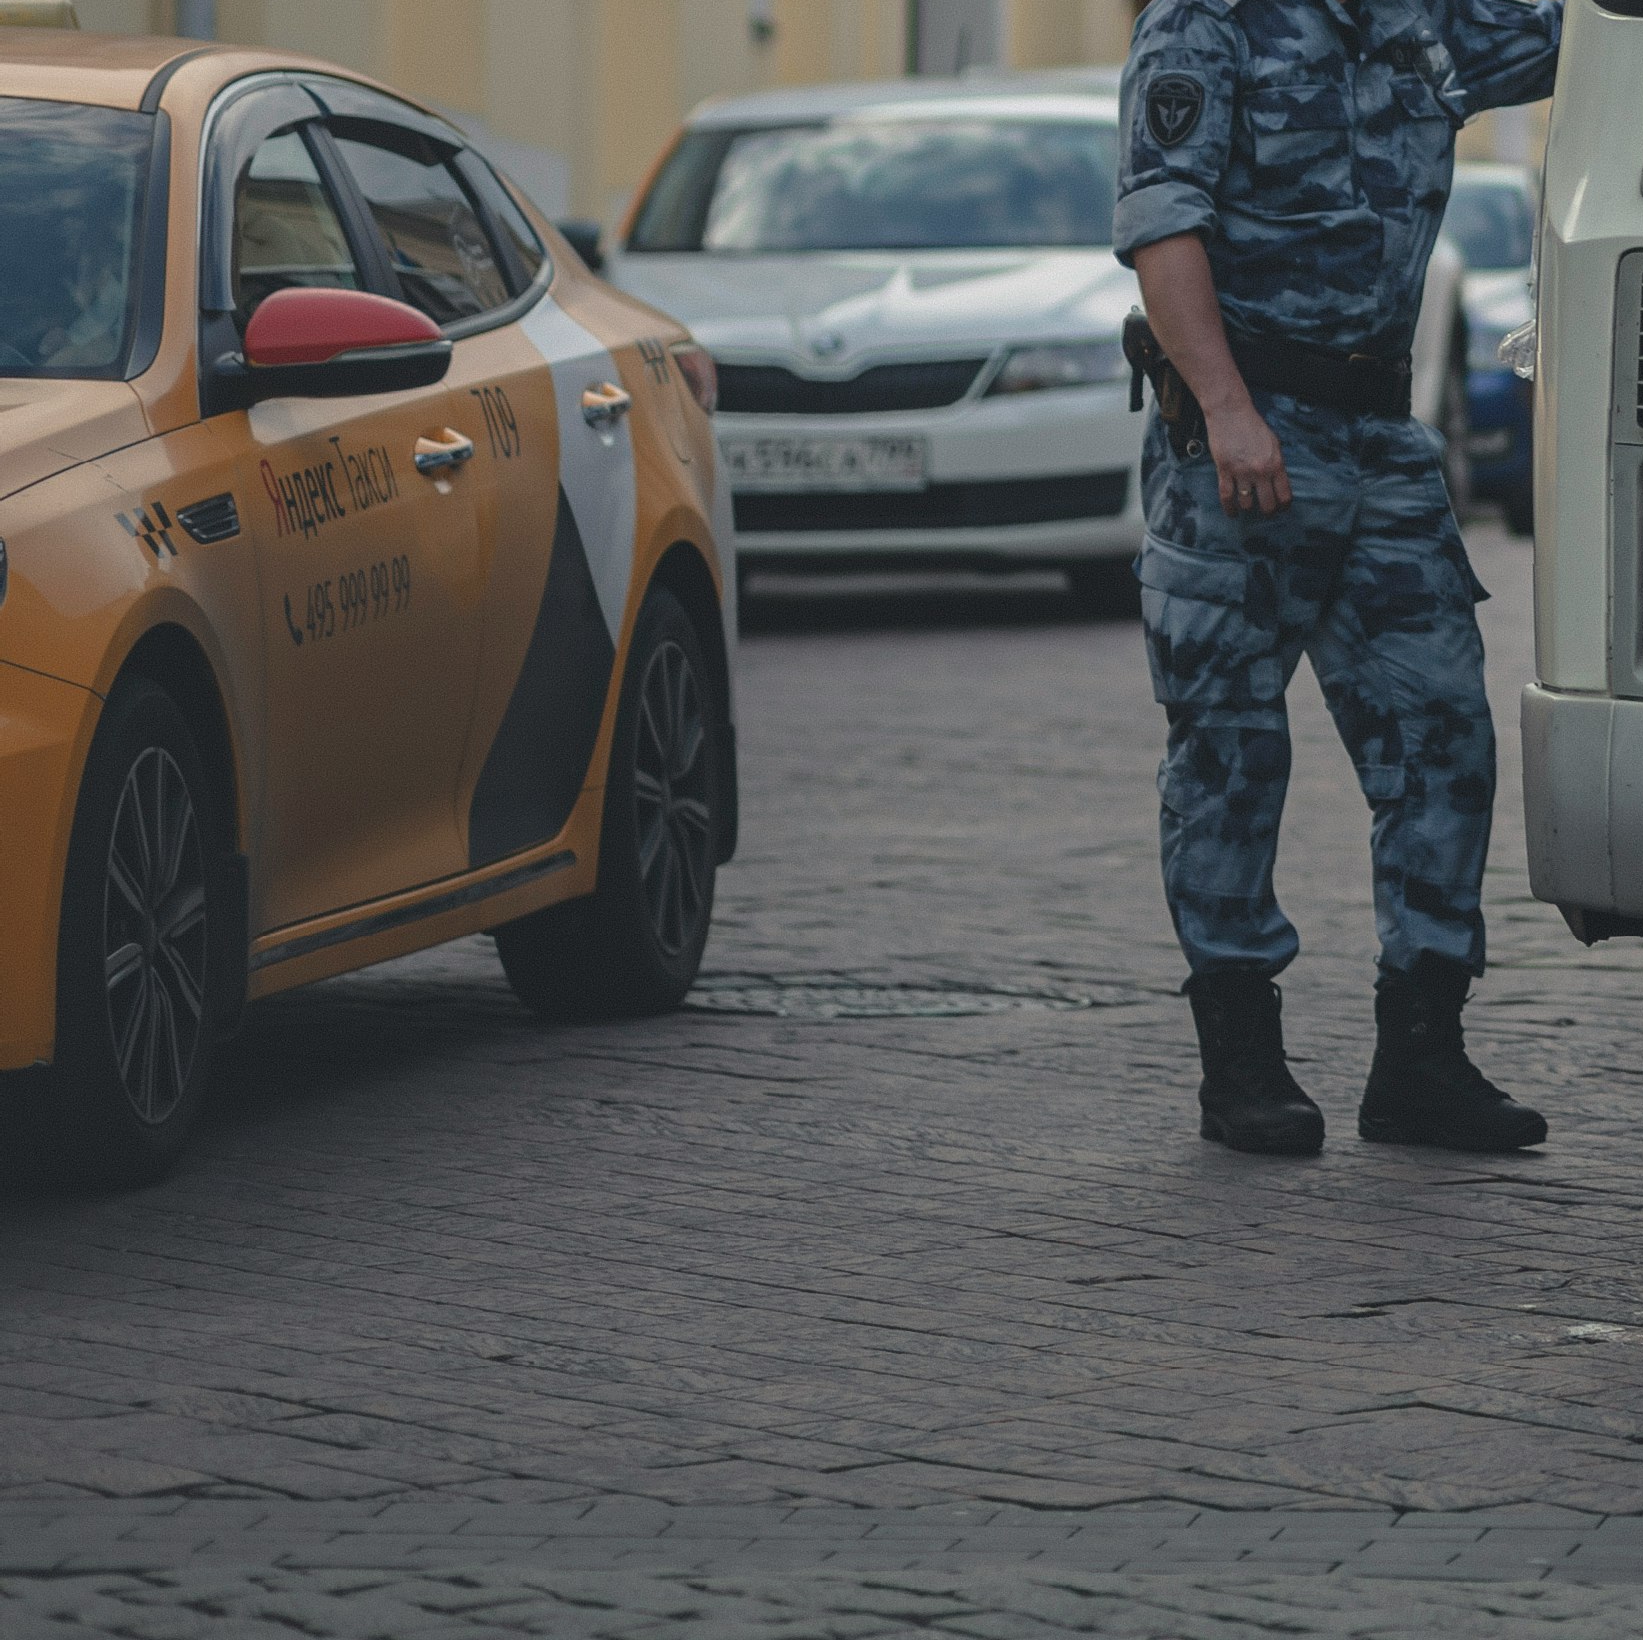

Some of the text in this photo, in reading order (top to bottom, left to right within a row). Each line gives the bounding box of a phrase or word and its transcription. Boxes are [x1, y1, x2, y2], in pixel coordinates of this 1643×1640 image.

[470, 385, 520, 458] 709
[260, 436, 399, 541] Яндекс Такси
[306, 554, 410, 641] 495 999 99 99
